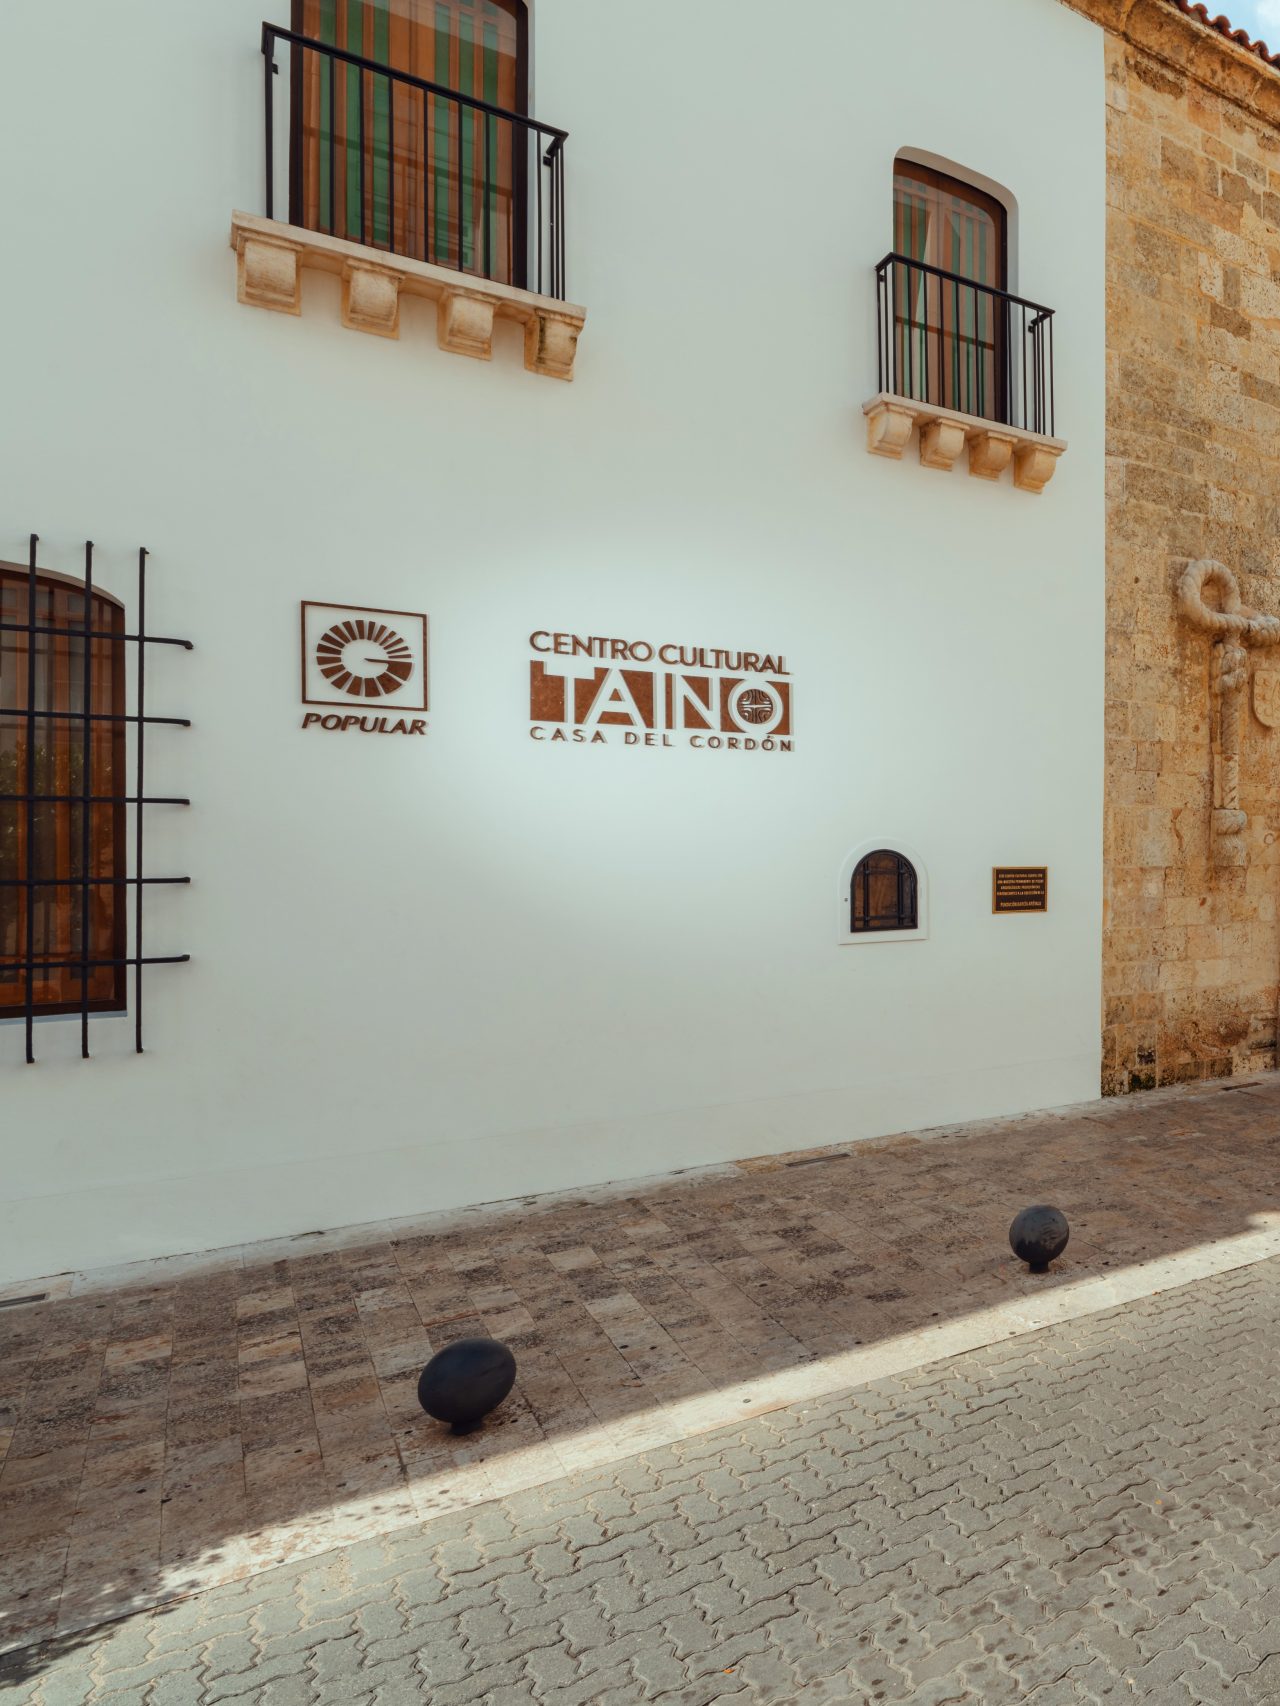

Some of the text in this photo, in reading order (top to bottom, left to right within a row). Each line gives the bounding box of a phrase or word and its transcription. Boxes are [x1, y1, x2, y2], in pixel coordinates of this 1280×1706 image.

[529, 630, 792, 675] CENTRO CULTURAL
[530, 660, 792, 735] TAINO
[302, 713, 427, 735] POPULAR
[530, 726, 793, 752] CASA DEL CORDÓN
